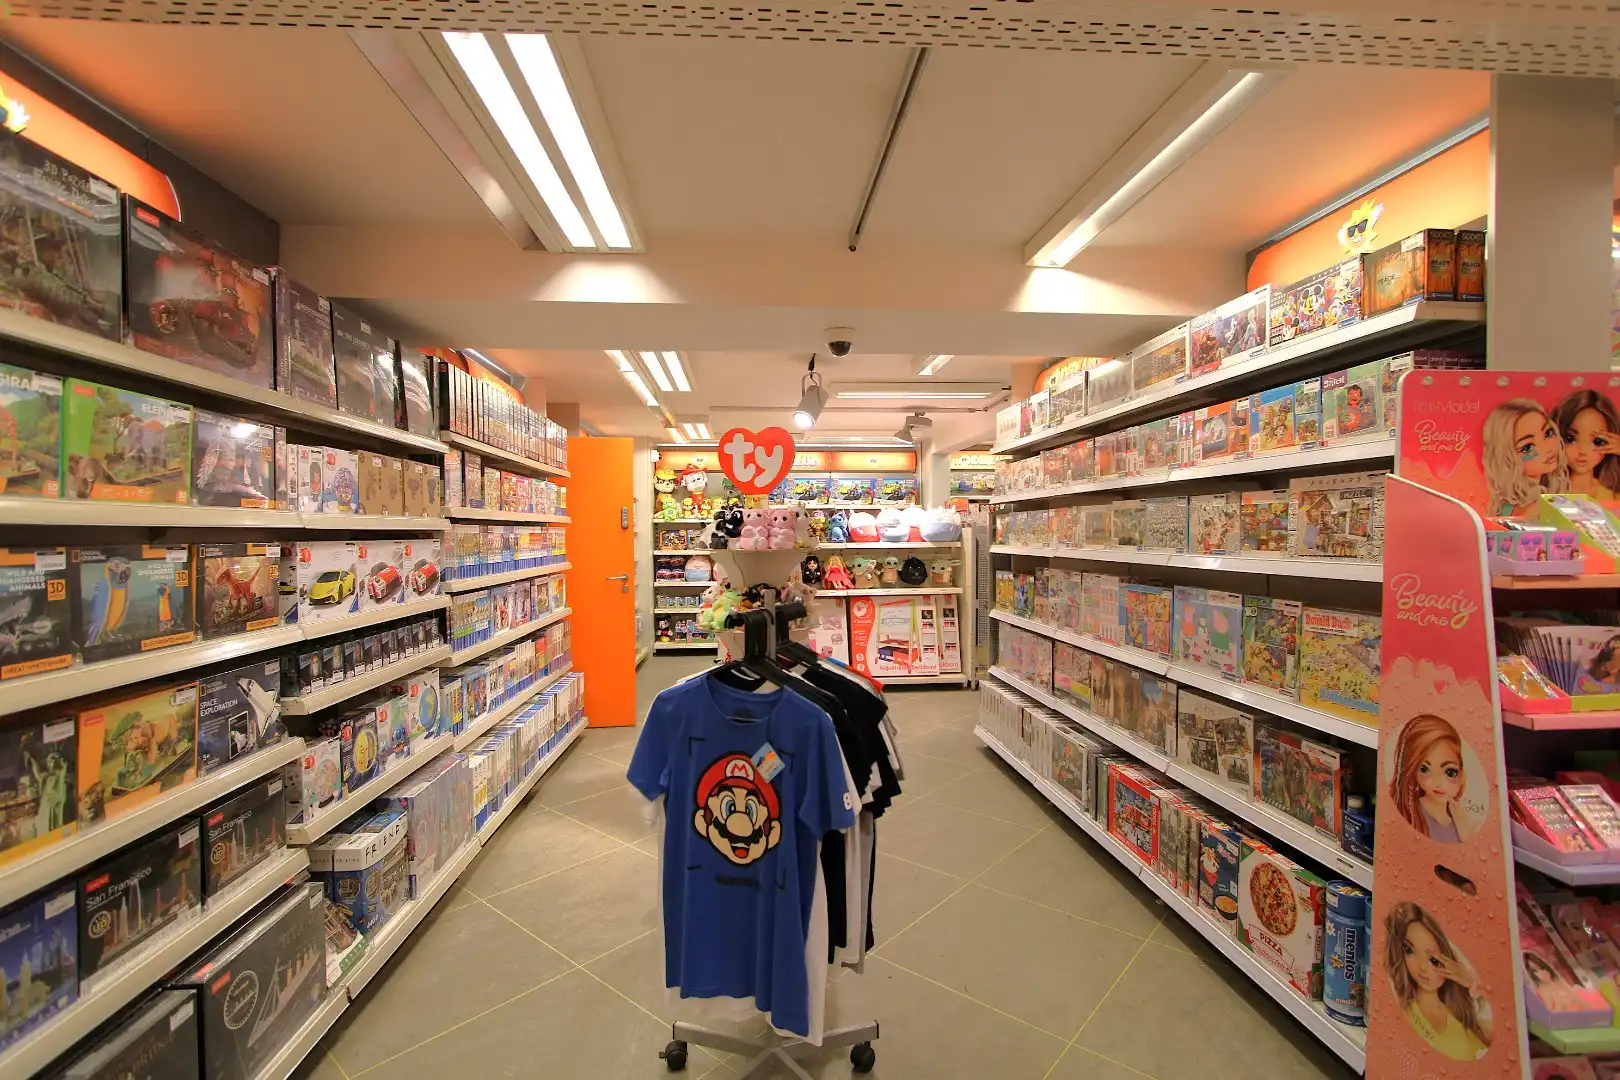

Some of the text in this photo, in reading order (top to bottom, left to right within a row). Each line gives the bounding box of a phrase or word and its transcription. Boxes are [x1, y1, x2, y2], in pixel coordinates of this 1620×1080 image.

[1414, 419, 1472, 452] Beauty
[1420, 442, 1440, 453] and
[723, 432, 784, 488] ty
[1310, 476, 1362, 486] FRIENDS
[177, 572, 188, 582] 3D
[9, 583, 46, 592] ANIMALS
[49, 582, 64, 594] 3D
[1390, 573, 1478, 630] Beauty
[1396, 608, 1449, 627] and me
[200, 698, 218, 710] SPACE
[200, 699, 238, 717] EXPLORATION
[730, 762, 750, 777] M
[208, 828, 221, 840] San
[222, 810, 252, 831] Francisco
[85, 892, 106, 910] San
[107, 866, 152, 898] Francisco
[92, 917, 107, 934] LED
[1259, 932, 1283, 957] PIZZA
[1344, 927, 1357, 981] mentos
